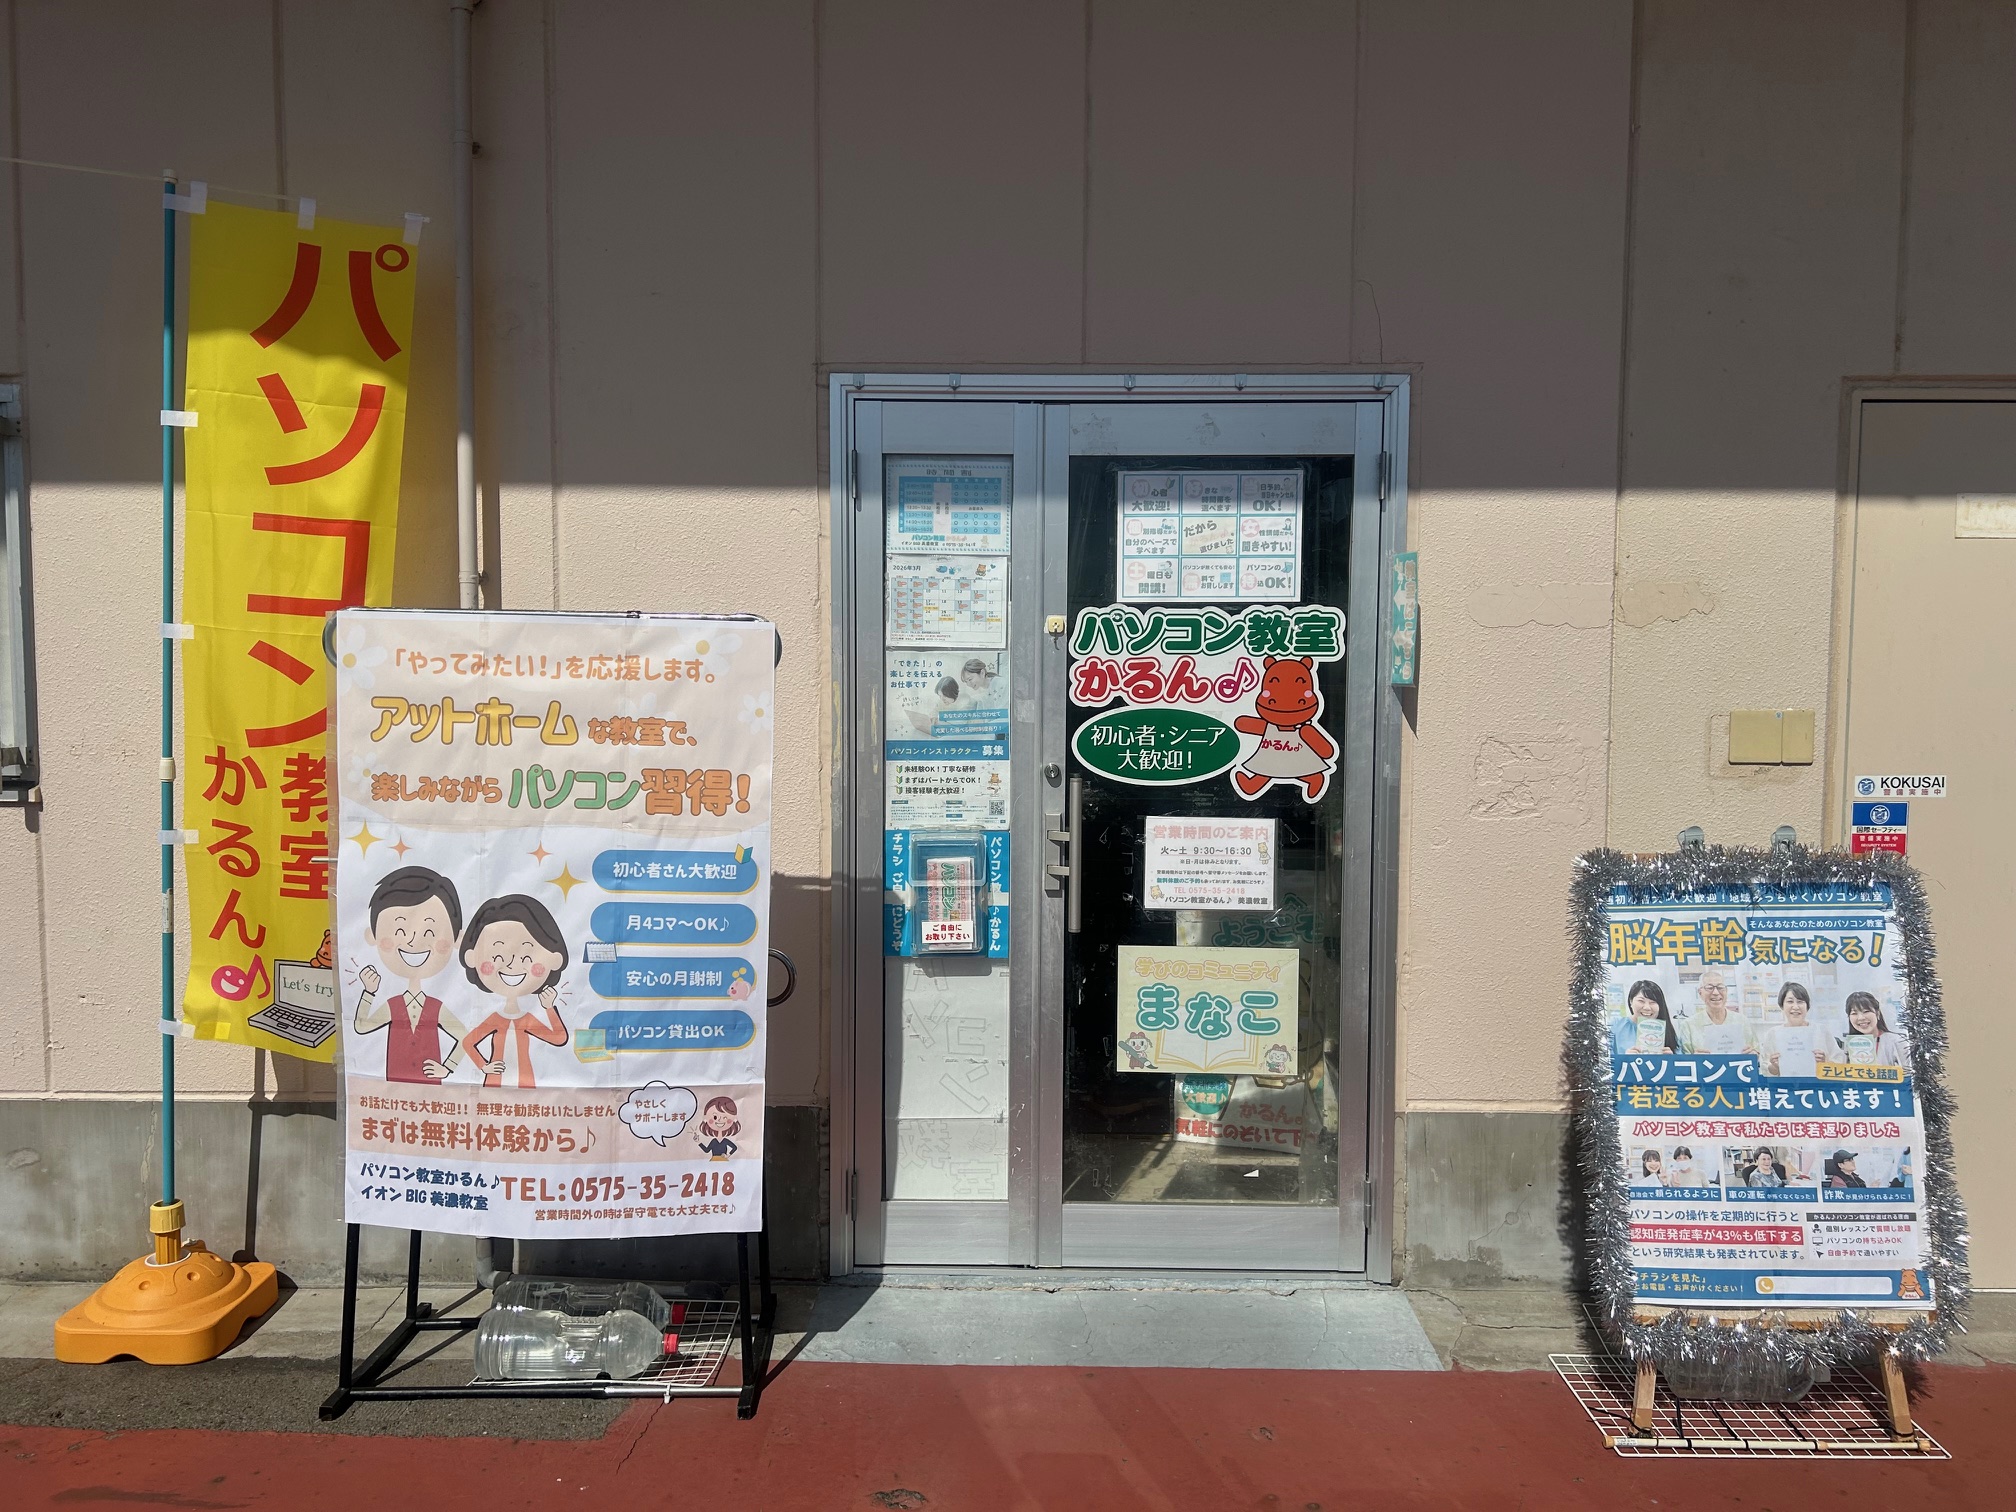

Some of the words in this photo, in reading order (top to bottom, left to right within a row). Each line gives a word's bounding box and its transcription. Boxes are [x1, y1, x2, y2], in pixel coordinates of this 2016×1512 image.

[1132, 500, 1170, 512] 大歓迎!
[1253, 500, 1282, 512] OK!
[1125, 538, 1177, 546] 自分のペースで
[1242, 540, 1292, 552] 聞きやすい!
[1074, 609, 1340, 656] パソコン教室
[890, 670, 942, 678] 楽しさを伝える
[982, 745, 1004, 756] 募集
[1117, 749, 1193, 771] 大歓迎!
[1880, 776, 1945, 788] KOKUSAI
[1883, 788, 1942, 796] 警備実施中
[1153, 825, 1269, 840] 営業時間のご案内
[612, 862, 738, 880] 初心者さん大歓迎
[932, 924, 963, 932] ご自由に
[1749, 919, 1884, 929] そんなあなたのためのパソコン教室
[925, 932, 971, 941] お取り下さい
[1135, 957, 1280, 982] 学びのコミュニティ
[626, 970, 723, 988] 安心の月謝制
[282, 976, 311, 993] Let's
[315, 982, 334, 998] try
[1136, 983, 1281, 1040] まなこ
[618, 1023, 726, 1041] パソコン貸出OK
[1617, 1056, 1755, 1083] パソコンで
[1821, 1064, 1899, 1081] テレビでも話題
[476, 1103, 616, 1119] 無理な勧誘はいたしません
[634, 1099, 668, 1109] やさしく
[634, 1111, 687, 1123] サポートします
[1632, 1120, 1901, 1139] パソコン教室で私たちは若返りました
[361, 1186, 402, 1201] イオン
[405, 1188, 427, 1204] BIG
[429, 1191, 489, 1212] 美濃教室
[1629, 1208, 1800, 1223] パソコンの操作を定期的に行うと
[1826, 1236, 1903, 1245] パソコンの持ち込みOK
[1631, 1247, 1805, 1261] という研究結果も発表されています。
[1827, 1248, 1900, 1257] 自由予約で通いやすい
